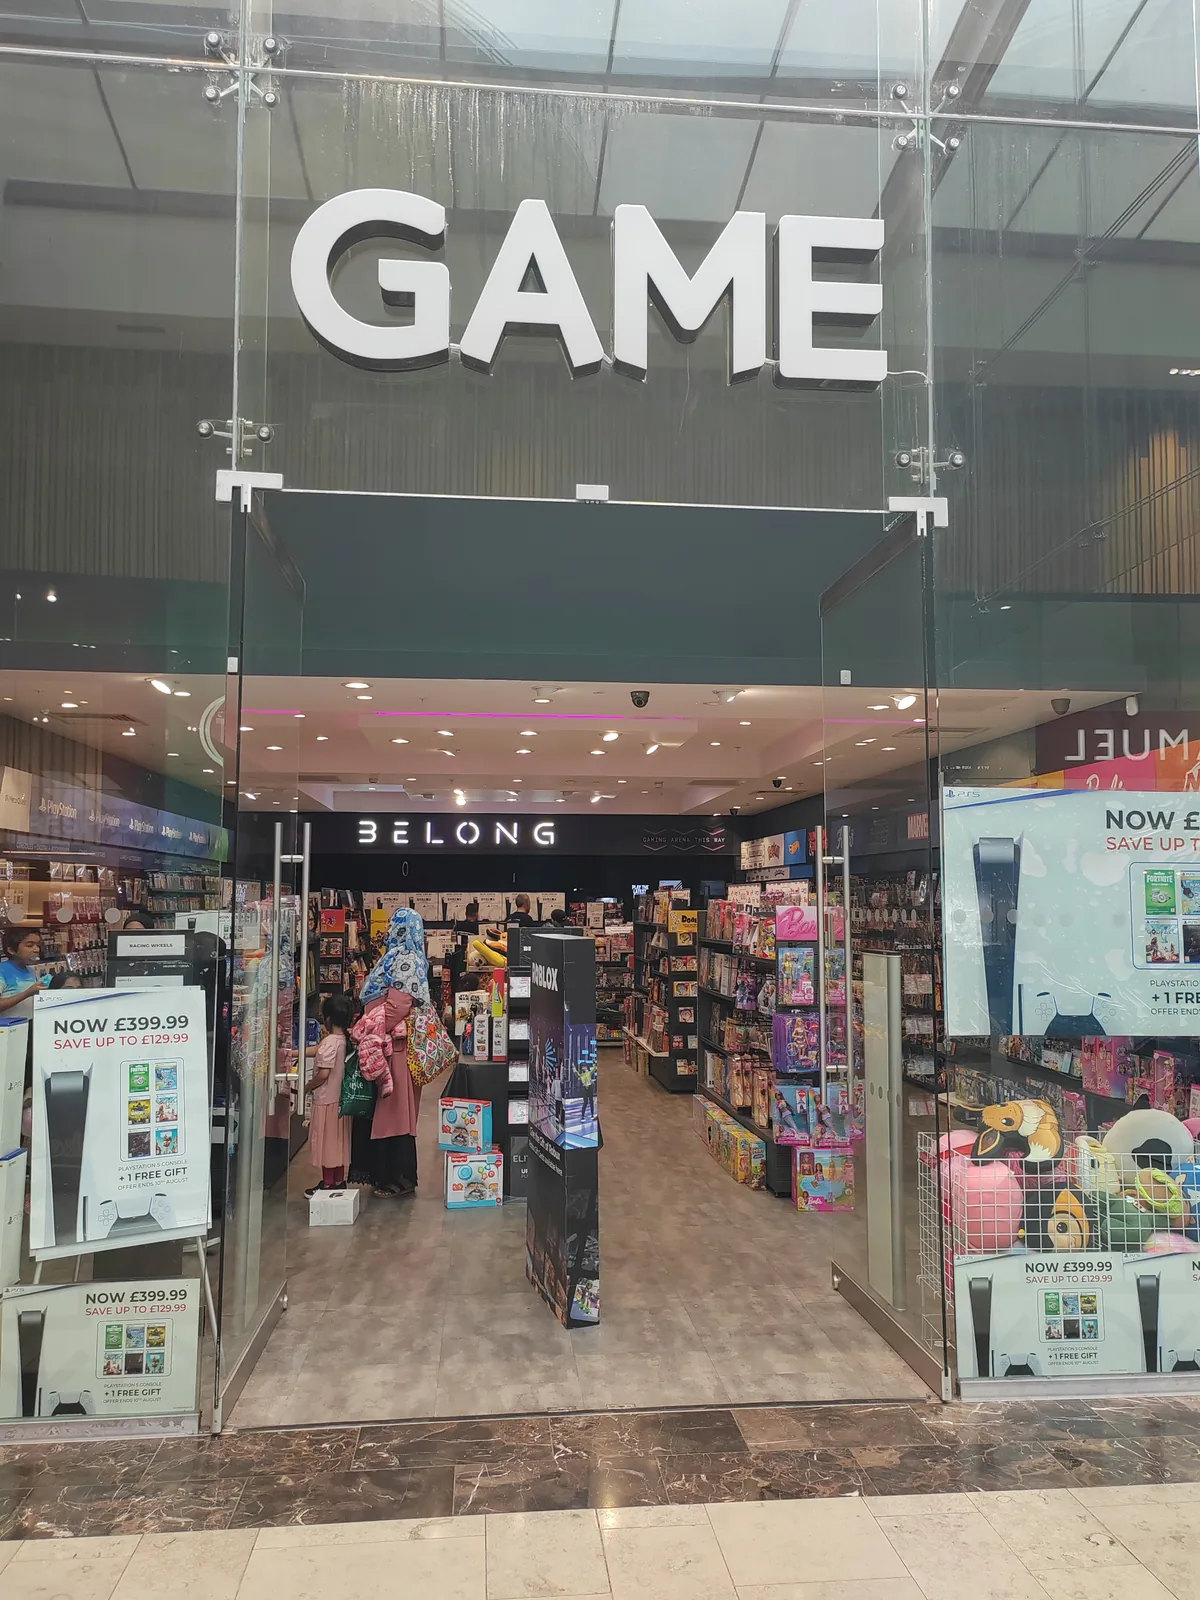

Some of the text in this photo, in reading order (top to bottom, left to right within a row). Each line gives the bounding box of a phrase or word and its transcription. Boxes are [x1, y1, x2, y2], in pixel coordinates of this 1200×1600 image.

[290, 187, 888, 388] GAME
[907, 812, 929, 839] MARVE
[1106, 809, 1175, 830] NOW
[358, 820, 555, 845] BELONG
[1106, 836, 1154, 851] SAVE
[1160, 837, 1185, 851] UP
[1146, 875, 1173, 883] FORTNITE
[1150, 979, 1200, 987] PLAYSTATIO
[1164, 991, 1170, 1004] 1
[1175, 991, 1200, 1004] FRE
[1150, 1007, 1200, 1015] OFFER END
[54, 1015, 189, 1034] NOW £399.99
[54, 1033, 189, 1050] SAVE UP TO £129.99
[118, 1163, 155, 1171] PLAYSTATION
[161, 1159, 187, 1167] CONSOLE
[128, 1173, 132, 1181] 1
[135, 1170, 161, 1181] FREE
[164, 1167, 188, 1177] GIFT
[118, 1183, 137, 1191] OFFER
[1025, 1261, 1113, 1273] NOW £399.99
[1025, 1274, 1113, 1284] SAVE UP TO £129.99
[86, 1289, 188, 1305] NOW £399.99
[85, 1303, 187, 1316] SAVE UP TO £129.99
[117, 1389, 140, 1397] FREE
[141, 1388, 162, 1396] GIFT
